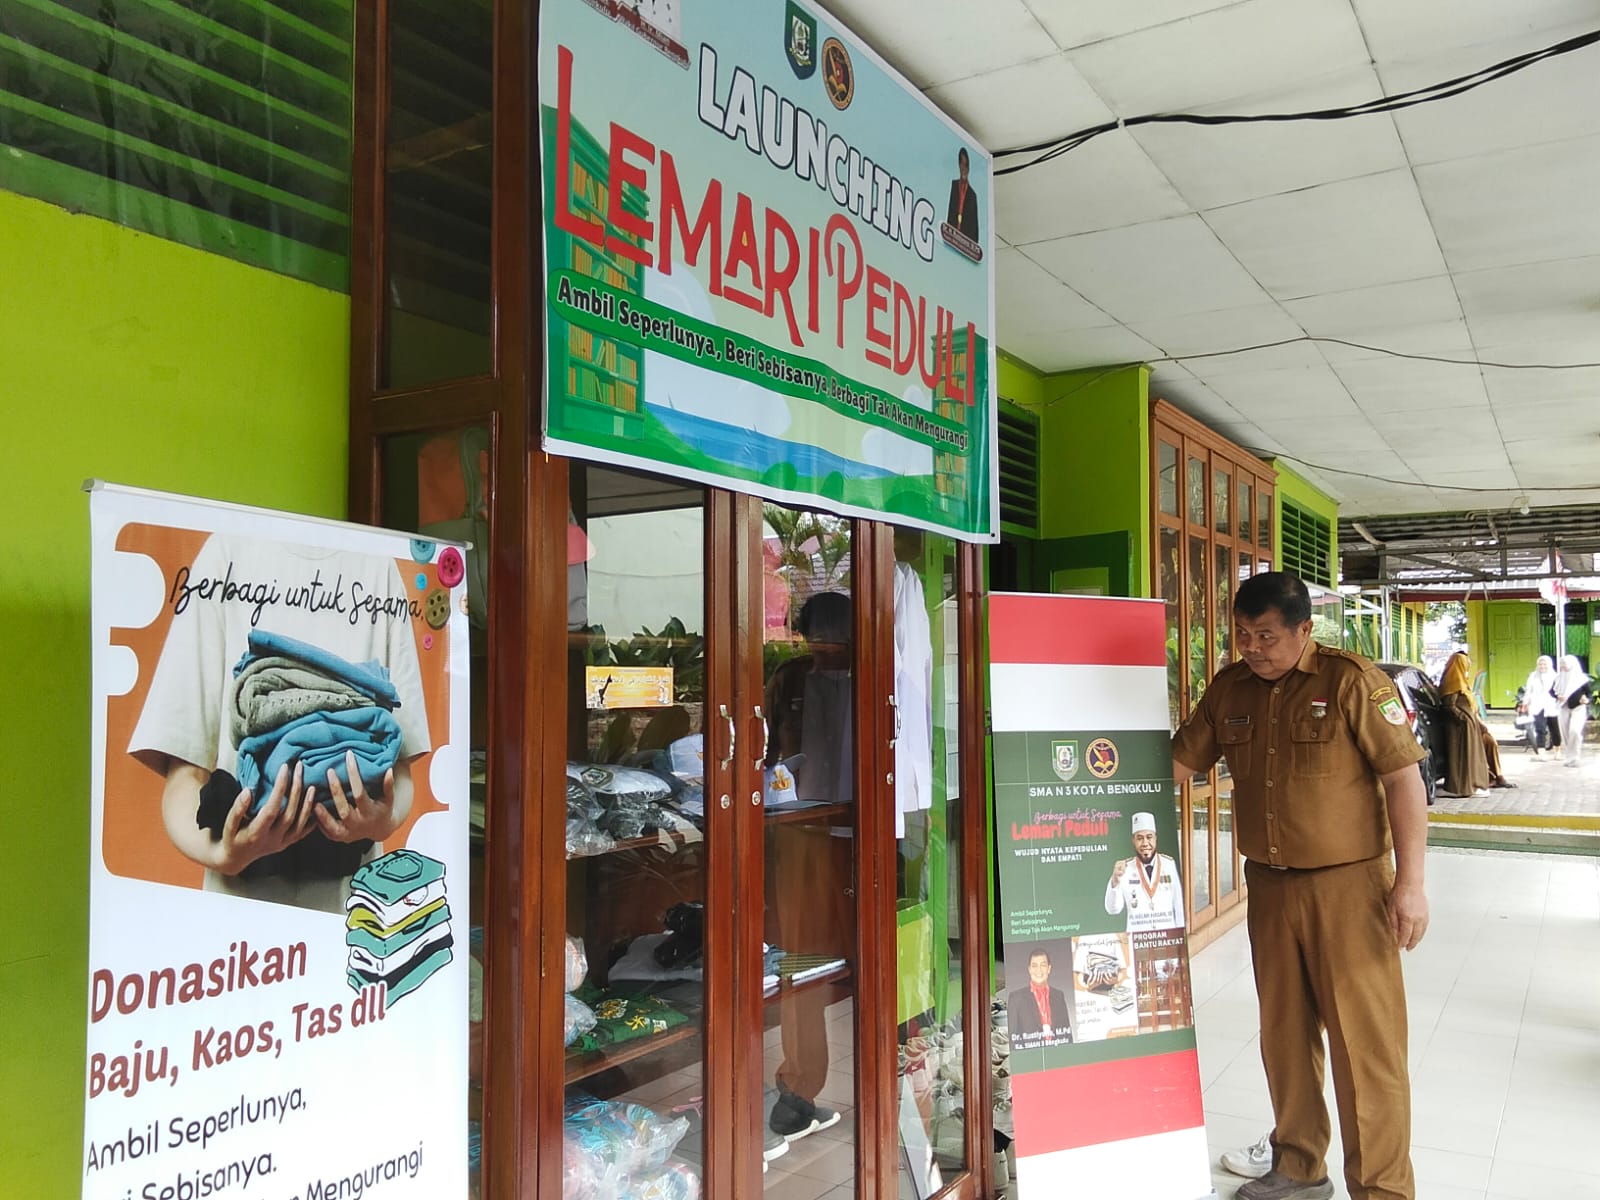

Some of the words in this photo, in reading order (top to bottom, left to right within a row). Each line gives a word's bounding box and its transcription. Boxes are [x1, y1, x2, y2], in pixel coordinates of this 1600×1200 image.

[697, 42, 936, 262] LAUNCHING
[554, 44, 820, 347] LEMARI
[823, 212, 976, 406] PEDULI
[558, 276, 614, 321] Ambil
[618, 300, 722, 362] Seperlunya,
[725, 339, 756, 368] Beri
[757, 353, 831, 396] Sebisanya,
[831, 377, 870, 418] Berbagi
[871, 395, 890, 418] Tak
[891, 405, 914, 429] Akan
[915, 415, 969, 451] Mengurangi
[170, 561, 281, 626] Berbagi
[285, 569, 346, 613] untuk
[1029, 787, 1053, 797] SMA
[1055, 786, 1064, 796] N
[1065, 786, 1072, 796] 3
[1073, 785, 1105, 795] KOTA
[1107, 783, 1161, 794] BENGKULU
[1011, 822, 1062, 841] Lemari
[1064, 819, 1109, 838] Peduli
[1014, 848, 1039, 857] WUJUD
[1041, 847, 1064, 856] NYATA
[1065, 844, 1108, 854] KEPEDULIAN
[1041, 855, 1056, 864] DAN
[1058, 854, 1082, 863] EMPATI
[1133, 931, 1167, 940] PROGRAM
[1134, 941, 1157, 950] BANTU
[1157, 937, 1184, 947] RAKYAT
[90, 940, 308, 1024] Donasikan
[89, 1040, 179, 1099] Baju,
[192, 1021, 283, 1072] Kaos,
[292, 1002, 342, 1042] Tas
[350, 982, 386, 1028] dll
[86, 1120, 159, 1176] Ambil
[168, 1087, 307, 1149] Seperlunya,
[142, 1152, 278, 1200] Sebisanya.
[306, 1140, 423, 1200] Mengurangi
